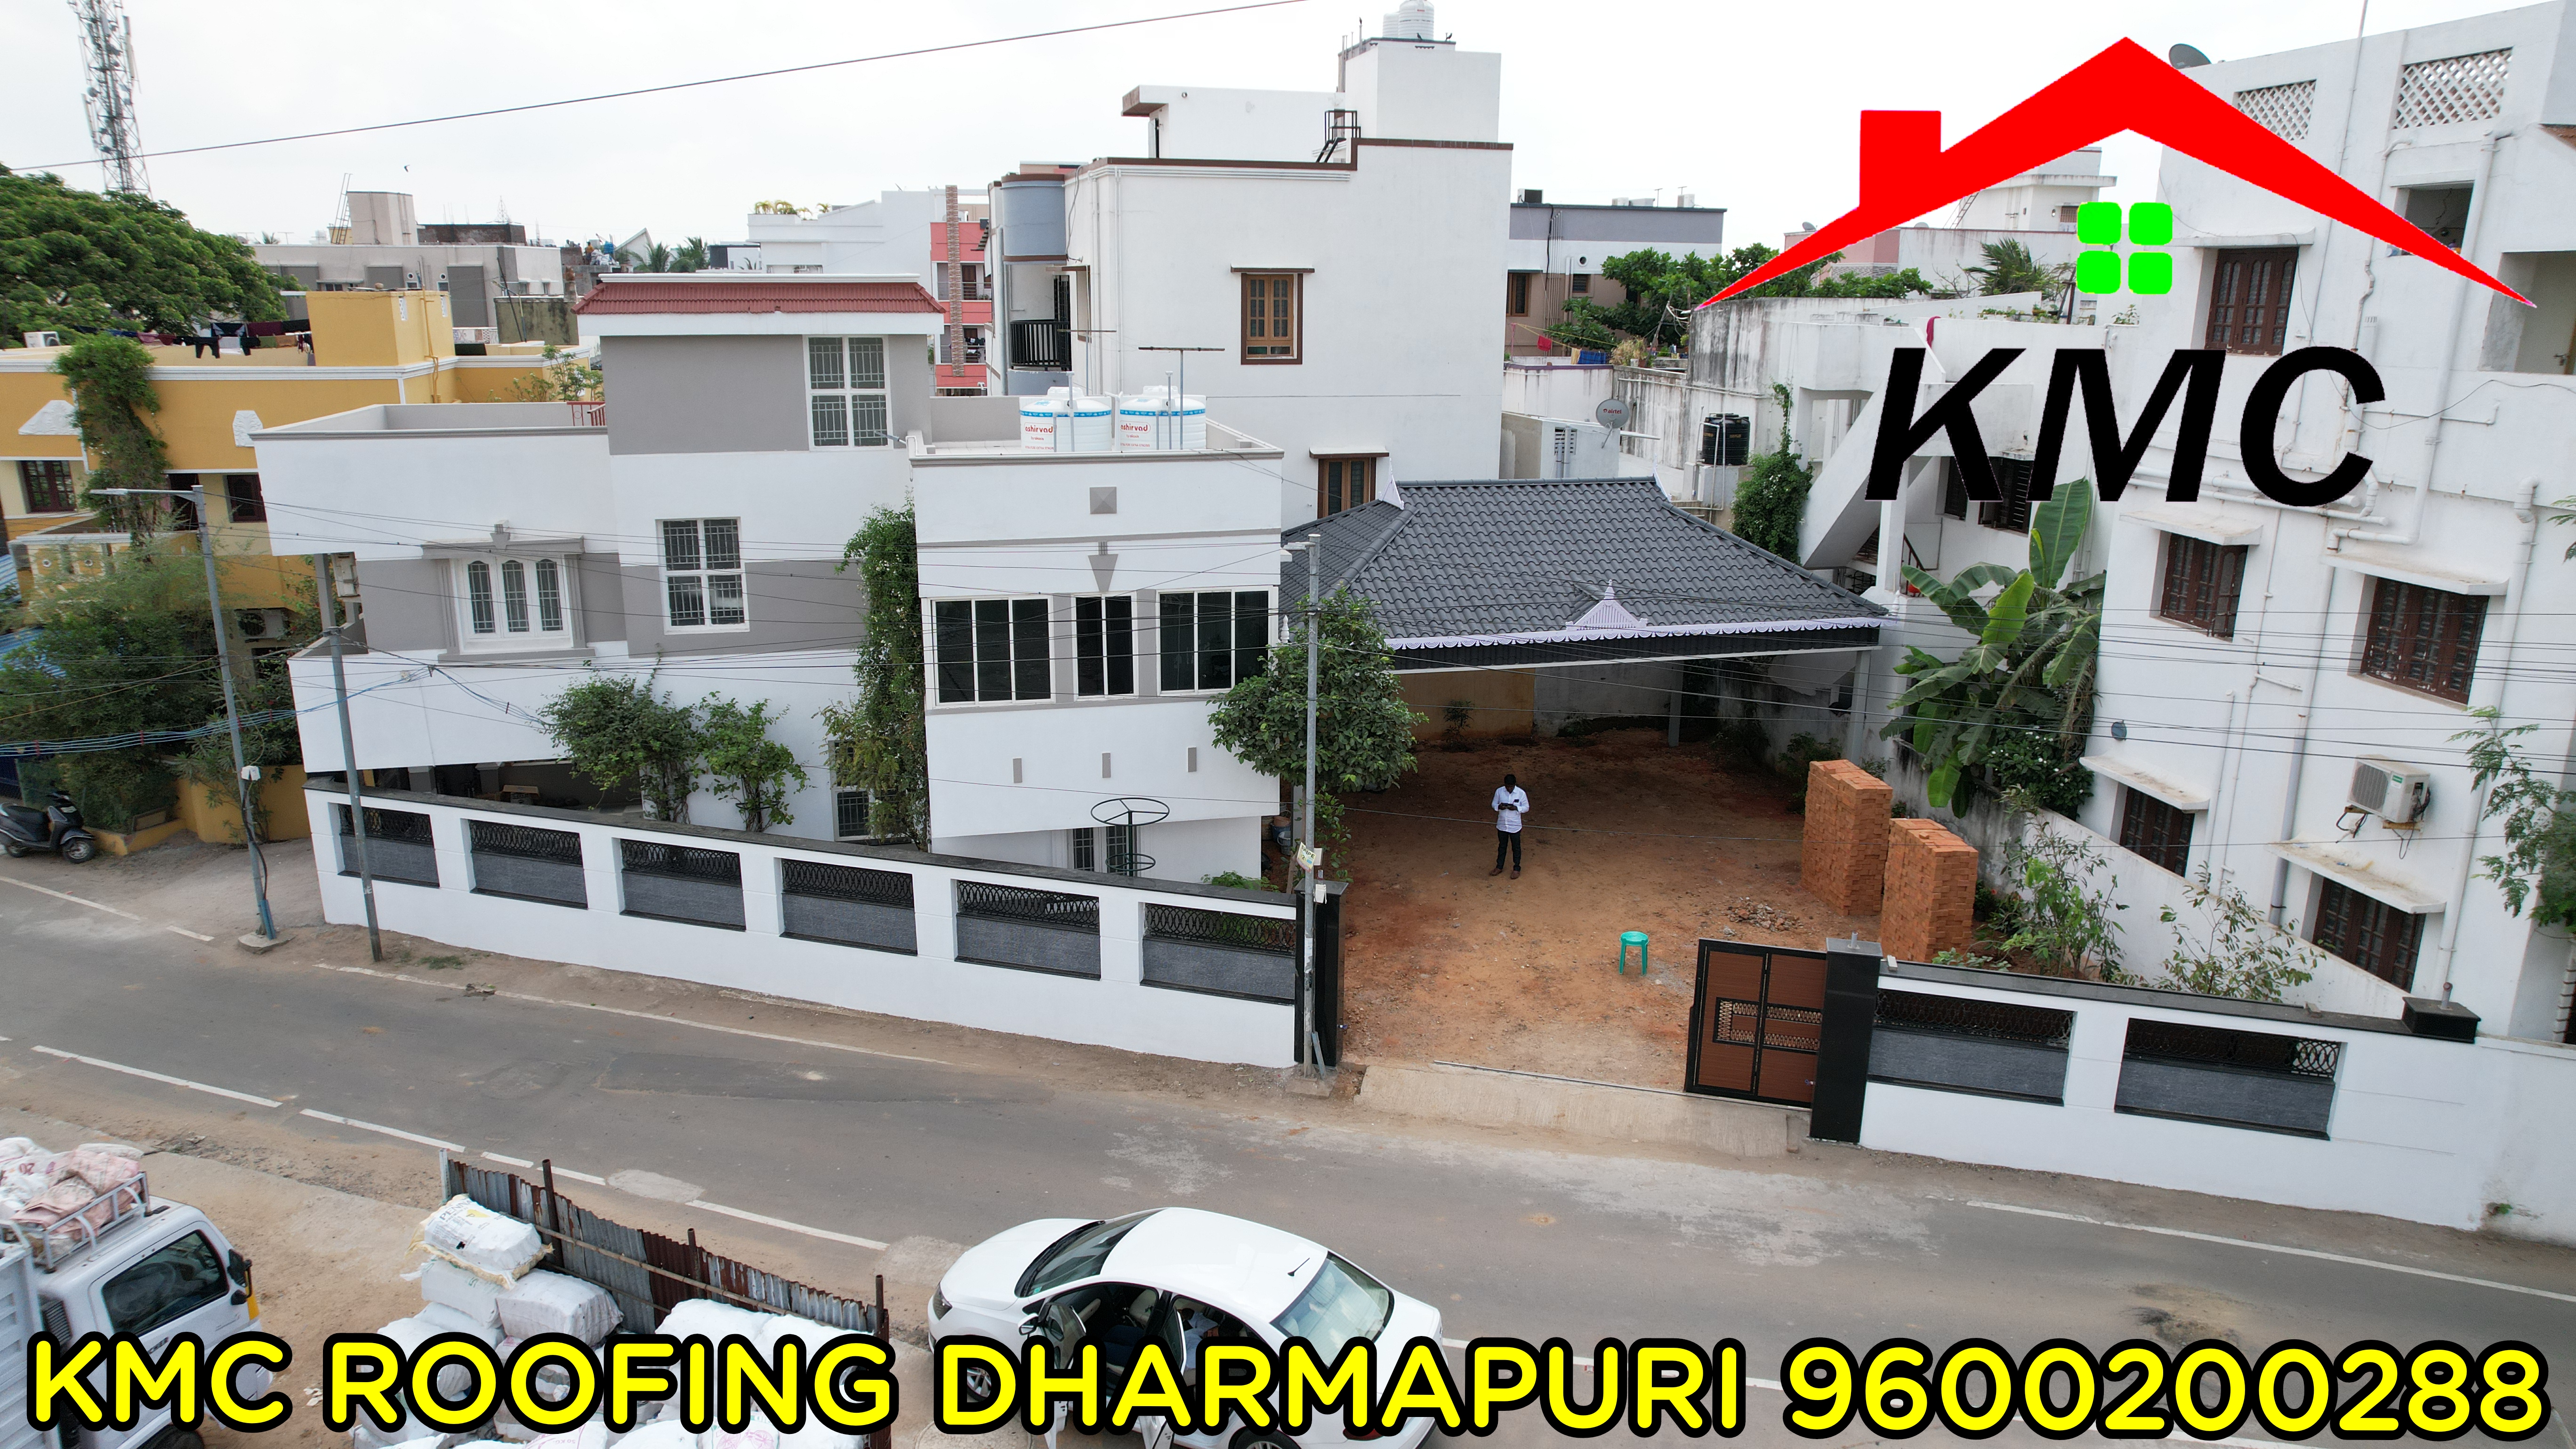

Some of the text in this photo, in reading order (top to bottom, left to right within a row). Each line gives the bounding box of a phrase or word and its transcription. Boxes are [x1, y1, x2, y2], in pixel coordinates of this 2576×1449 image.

[1025, 425, 1053, 433] ashirvad
[1120, 423, 1148, 431] ashirvad
[439, 1200, 472, 1221] PENNA
[147, 1336, 169, 1355] CHER
